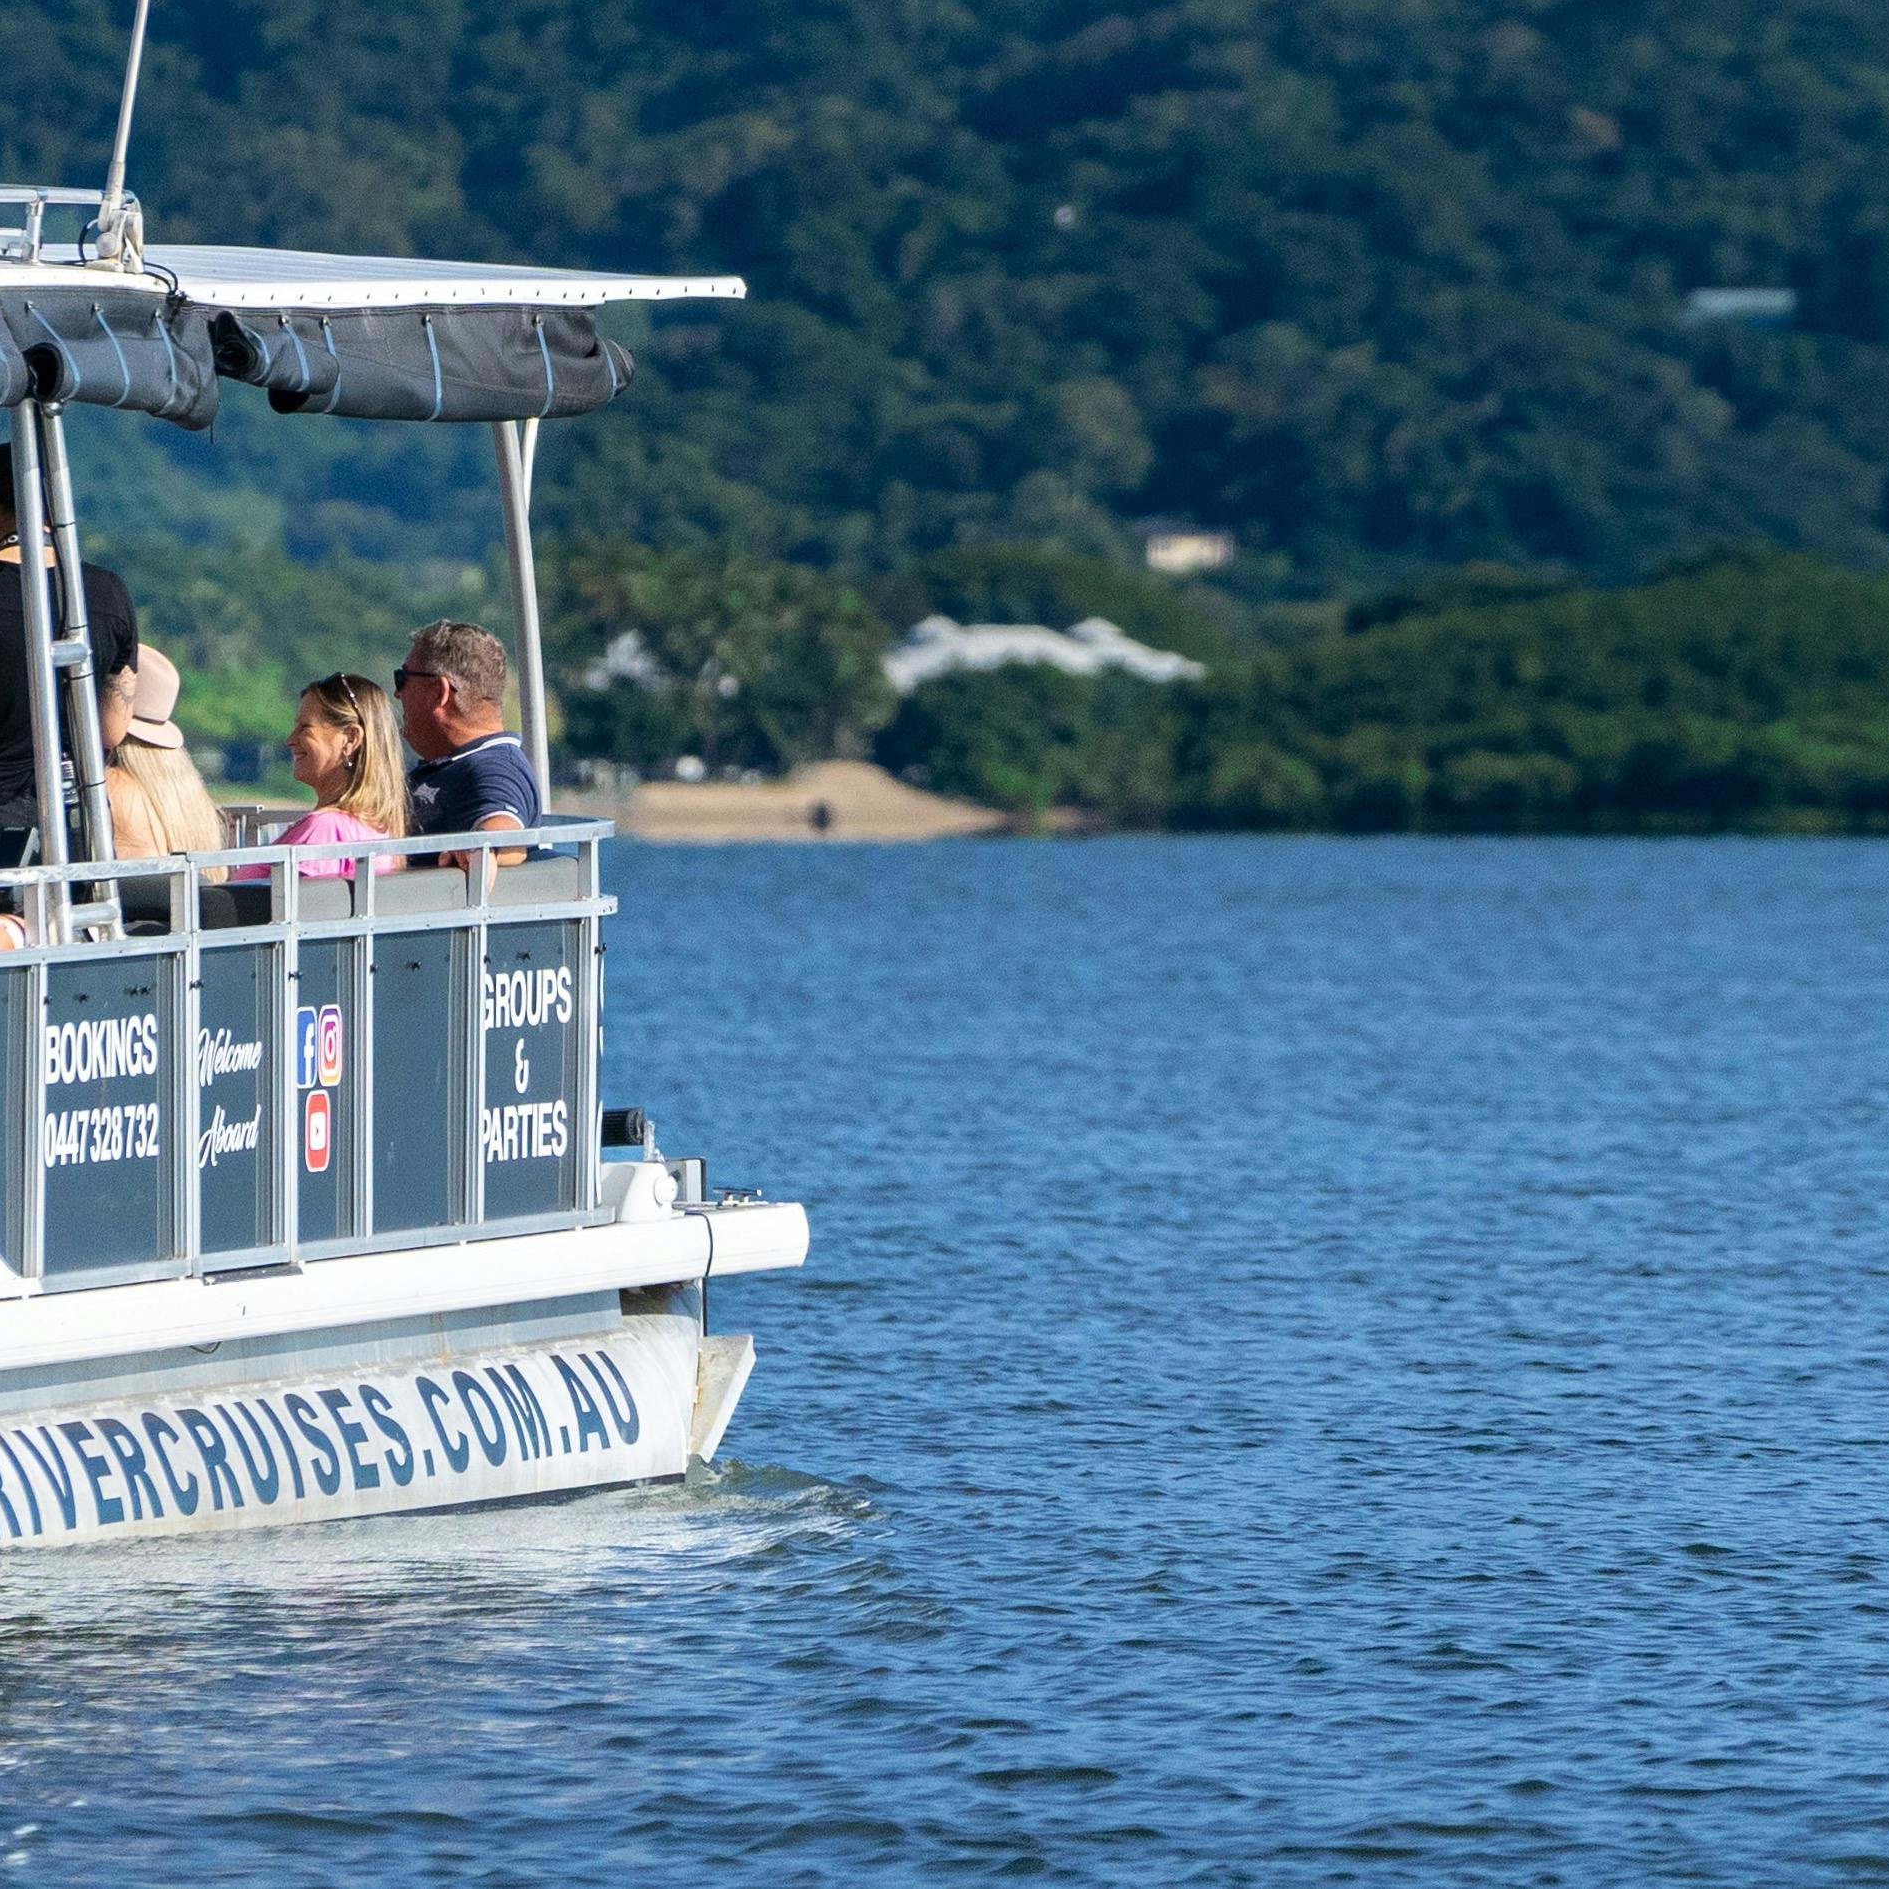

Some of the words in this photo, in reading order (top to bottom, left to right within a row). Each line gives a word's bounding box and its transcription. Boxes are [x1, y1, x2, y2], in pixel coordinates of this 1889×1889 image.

[484, 966, 573, 1030] GROUPS
[45, 1014, 158, 1085] BOOKINGS
[197, 1028, 263, 1087] Welcome
[515, 1038, 530, 1094] &
[197, 1104, 262, 1169] Aboard
[481, 1100, 569, 1163] PARTIES
